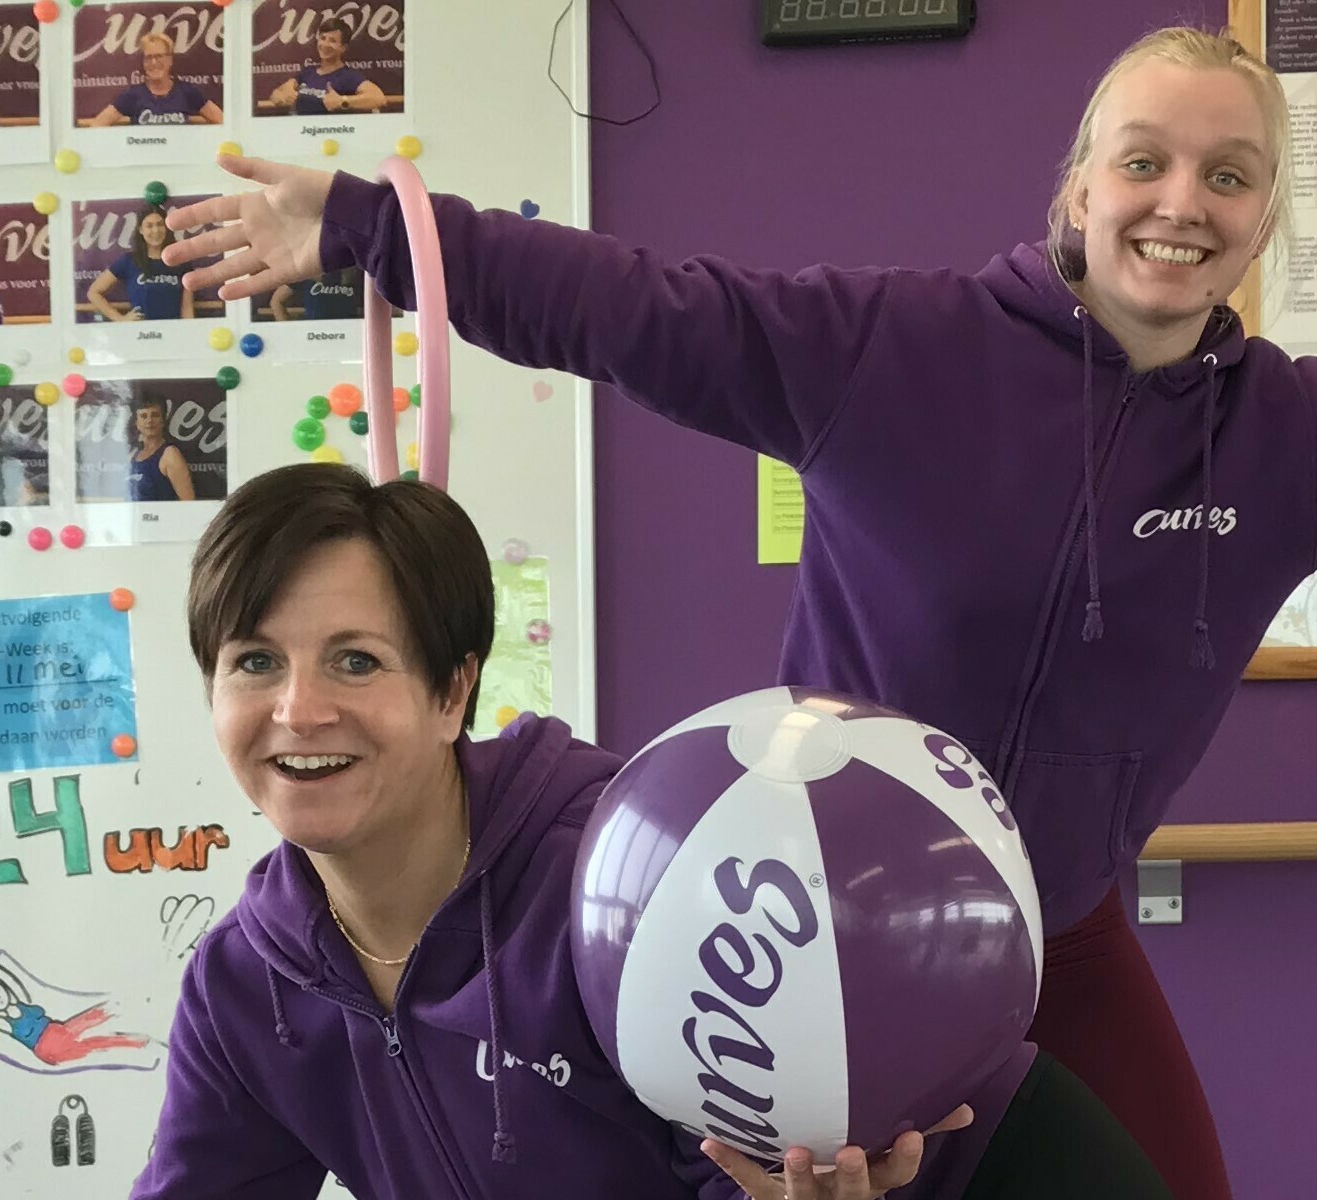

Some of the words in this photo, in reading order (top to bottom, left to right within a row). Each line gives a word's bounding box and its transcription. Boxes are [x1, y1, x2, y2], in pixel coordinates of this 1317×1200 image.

[126, 136, 167, 145] Deanne
[310, 281, 354, 296] Curves
[137, 331, 162, 340] Julia
[307, 332, 346, 341] Debora
[142, 513, 159, 522] Ria
[34, 655, 83, 681] mei
[3, 698, 46, 714] moet
[53, 696, 88, 711] voor
[94, 692, 114, 708] de
[45, 725, 107, 741] worden
[103, 822, 230, 876] uur
